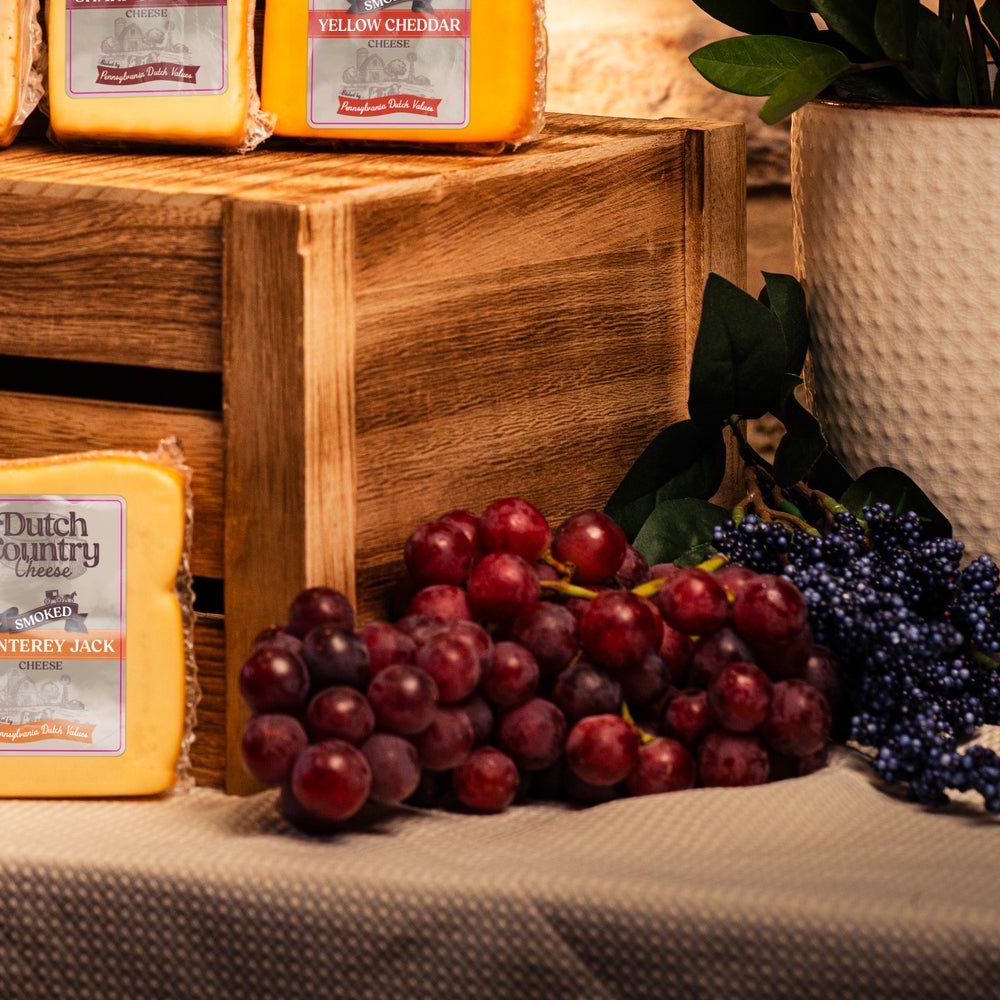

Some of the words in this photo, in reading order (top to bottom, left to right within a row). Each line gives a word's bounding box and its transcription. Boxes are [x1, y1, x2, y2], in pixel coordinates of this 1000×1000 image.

[126, 9, 167, 17] CHEESE
[319, 18, 381, 32] YELLOW
[385, 18, 460, 31] CHEDDAR
[368, 40, 410, 48] CHEESE
[100, 71, 145, 83] Pennsylvania
[146, 67, 168, 76] Dutch
[171, 68, 192, 79] Values
[341, 102, 386, 114] Pennsylvania
[388, 99, 409, 109] Dutch
[413, 101, 434, 111] Values
[16, 556, 72, 578] Cheese
[15, 606, 72, 630] SMOKED
[70, 639, 115, 653] JACK
[19, 661, 62, 670] CHEESE
[41, 725, 62, 735] Dutch
[67, 726, 88, 738] Values
